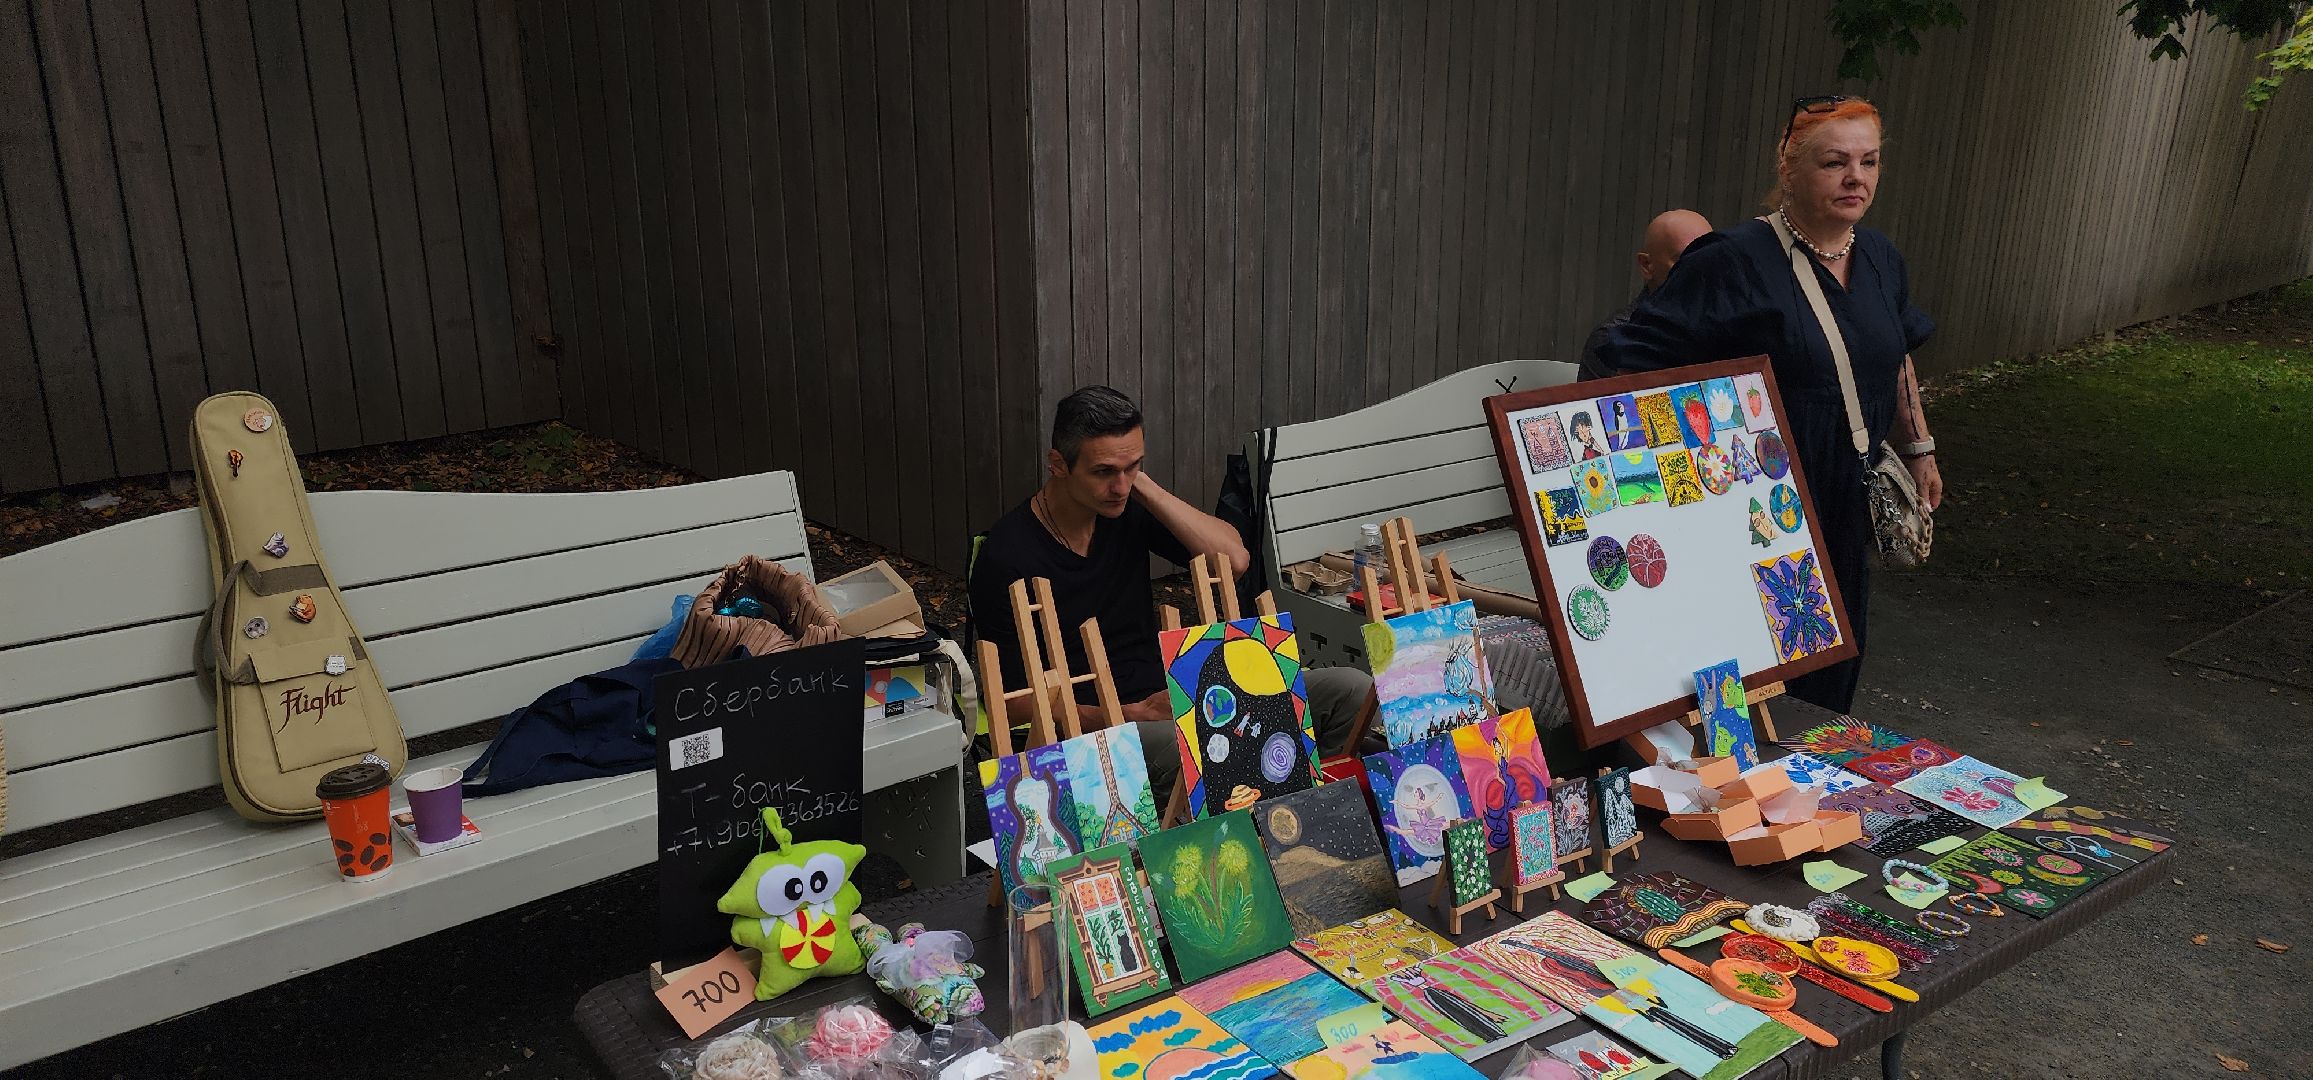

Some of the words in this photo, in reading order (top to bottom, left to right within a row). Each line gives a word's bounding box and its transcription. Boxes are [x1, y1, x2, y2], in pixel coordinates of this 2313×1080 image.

[275, 680, 357, 735] Flight
[674, 665, 849, 722] Сбербанк
[681, 970, 741, 1013] 700
[1330, 1022, 1358, 1045] 300
